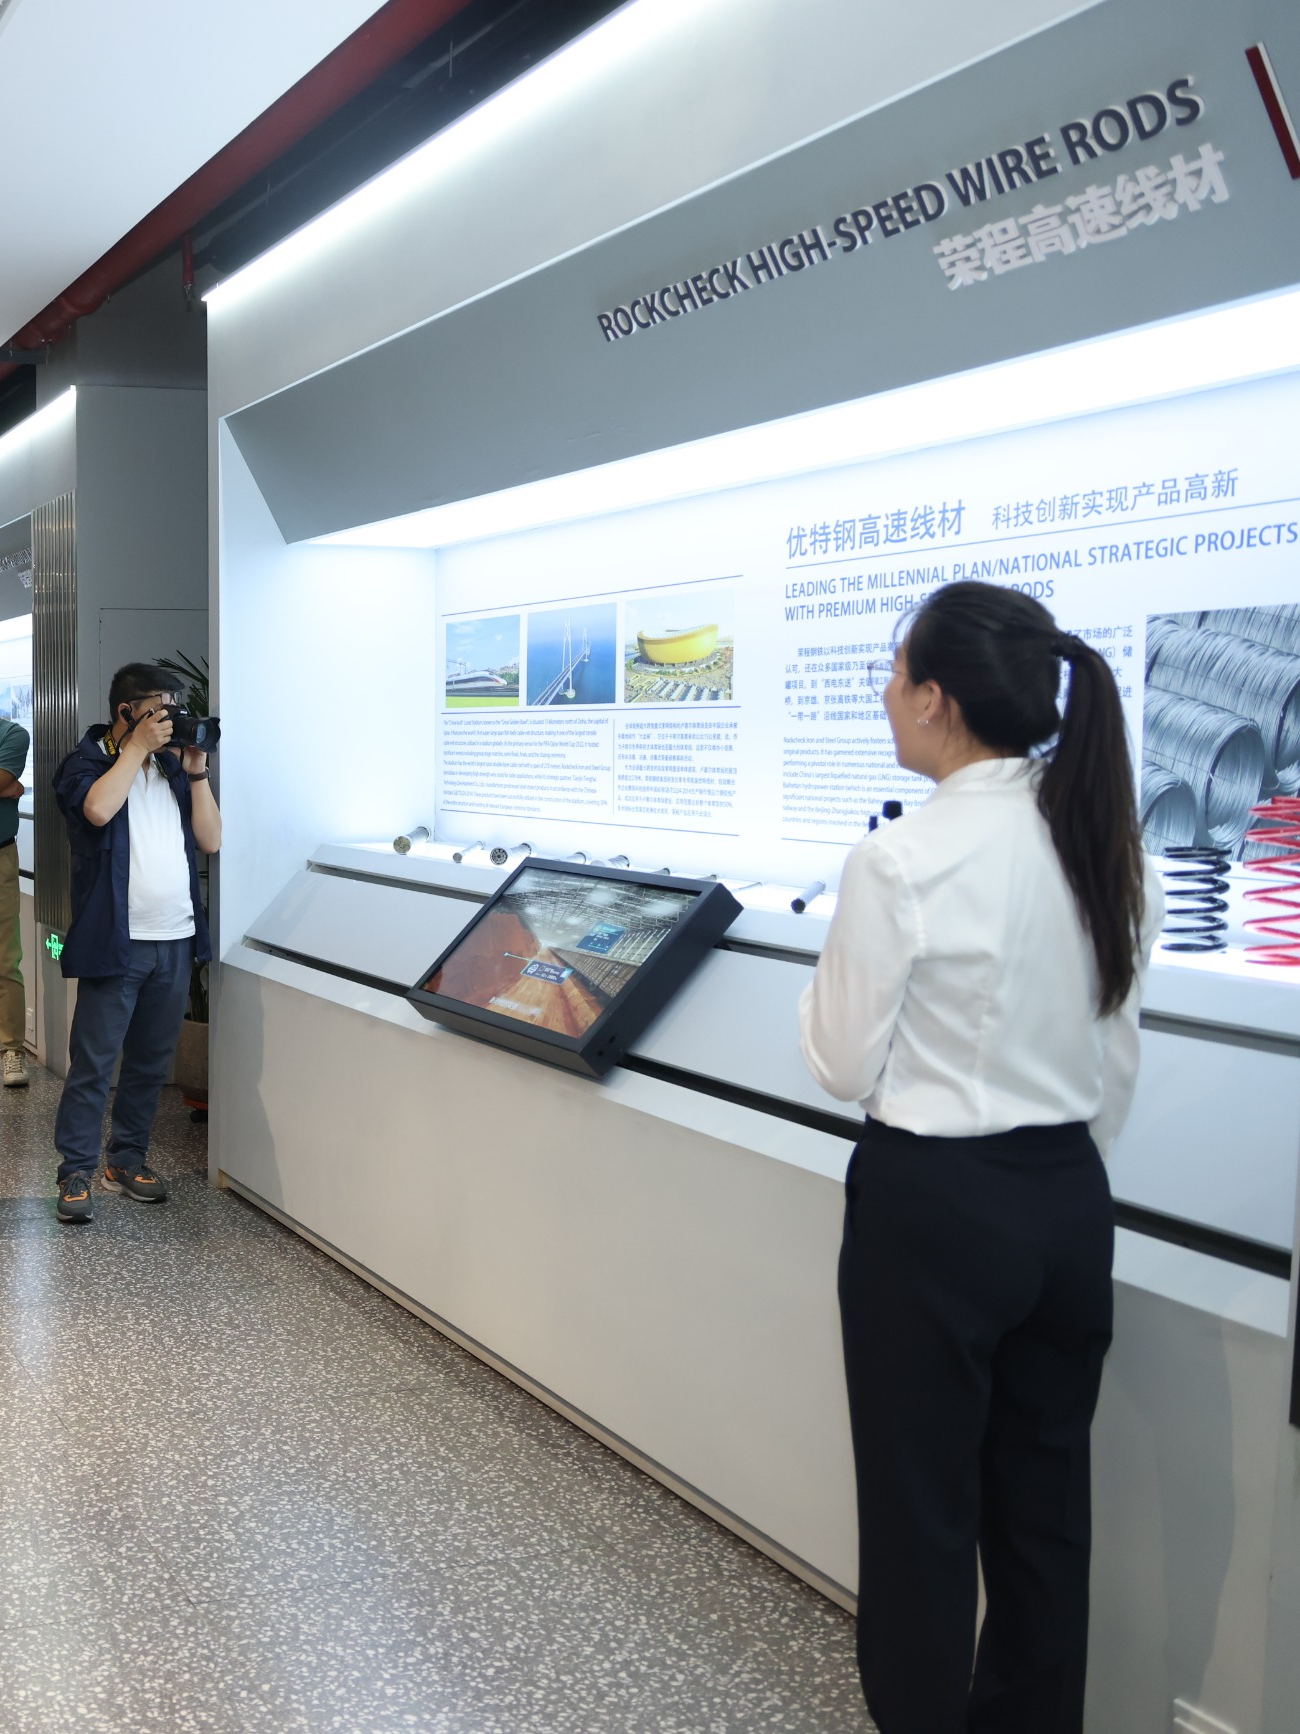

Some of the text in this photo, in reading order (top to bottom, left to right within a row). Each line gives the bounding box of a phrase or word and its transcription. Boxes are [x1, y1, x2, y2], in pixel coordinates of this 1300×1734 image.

[596, 75, 1204, 342] ROCKCHECK HIGH-SPEED WIRE RODS
[932, 142, 1229, 291] 荣程高速线材
[786, 468, 1239, 559] 优特钢高速线材 科技创新实现产品高新
[785, 521, 1299, 599] LEADING THE MILLENNIAL PLAN/NATIONAL STRATEGIC PROJECTS
[784, 604, 815, 621] WITH
[818, 598, 877, 619] PREMIUM
[880, 592, 931, 613] HIGH-S
[836, 737, 851, 745] Group
[891, 773, 909, 782] storage
[894, 785, 923, 795] component
